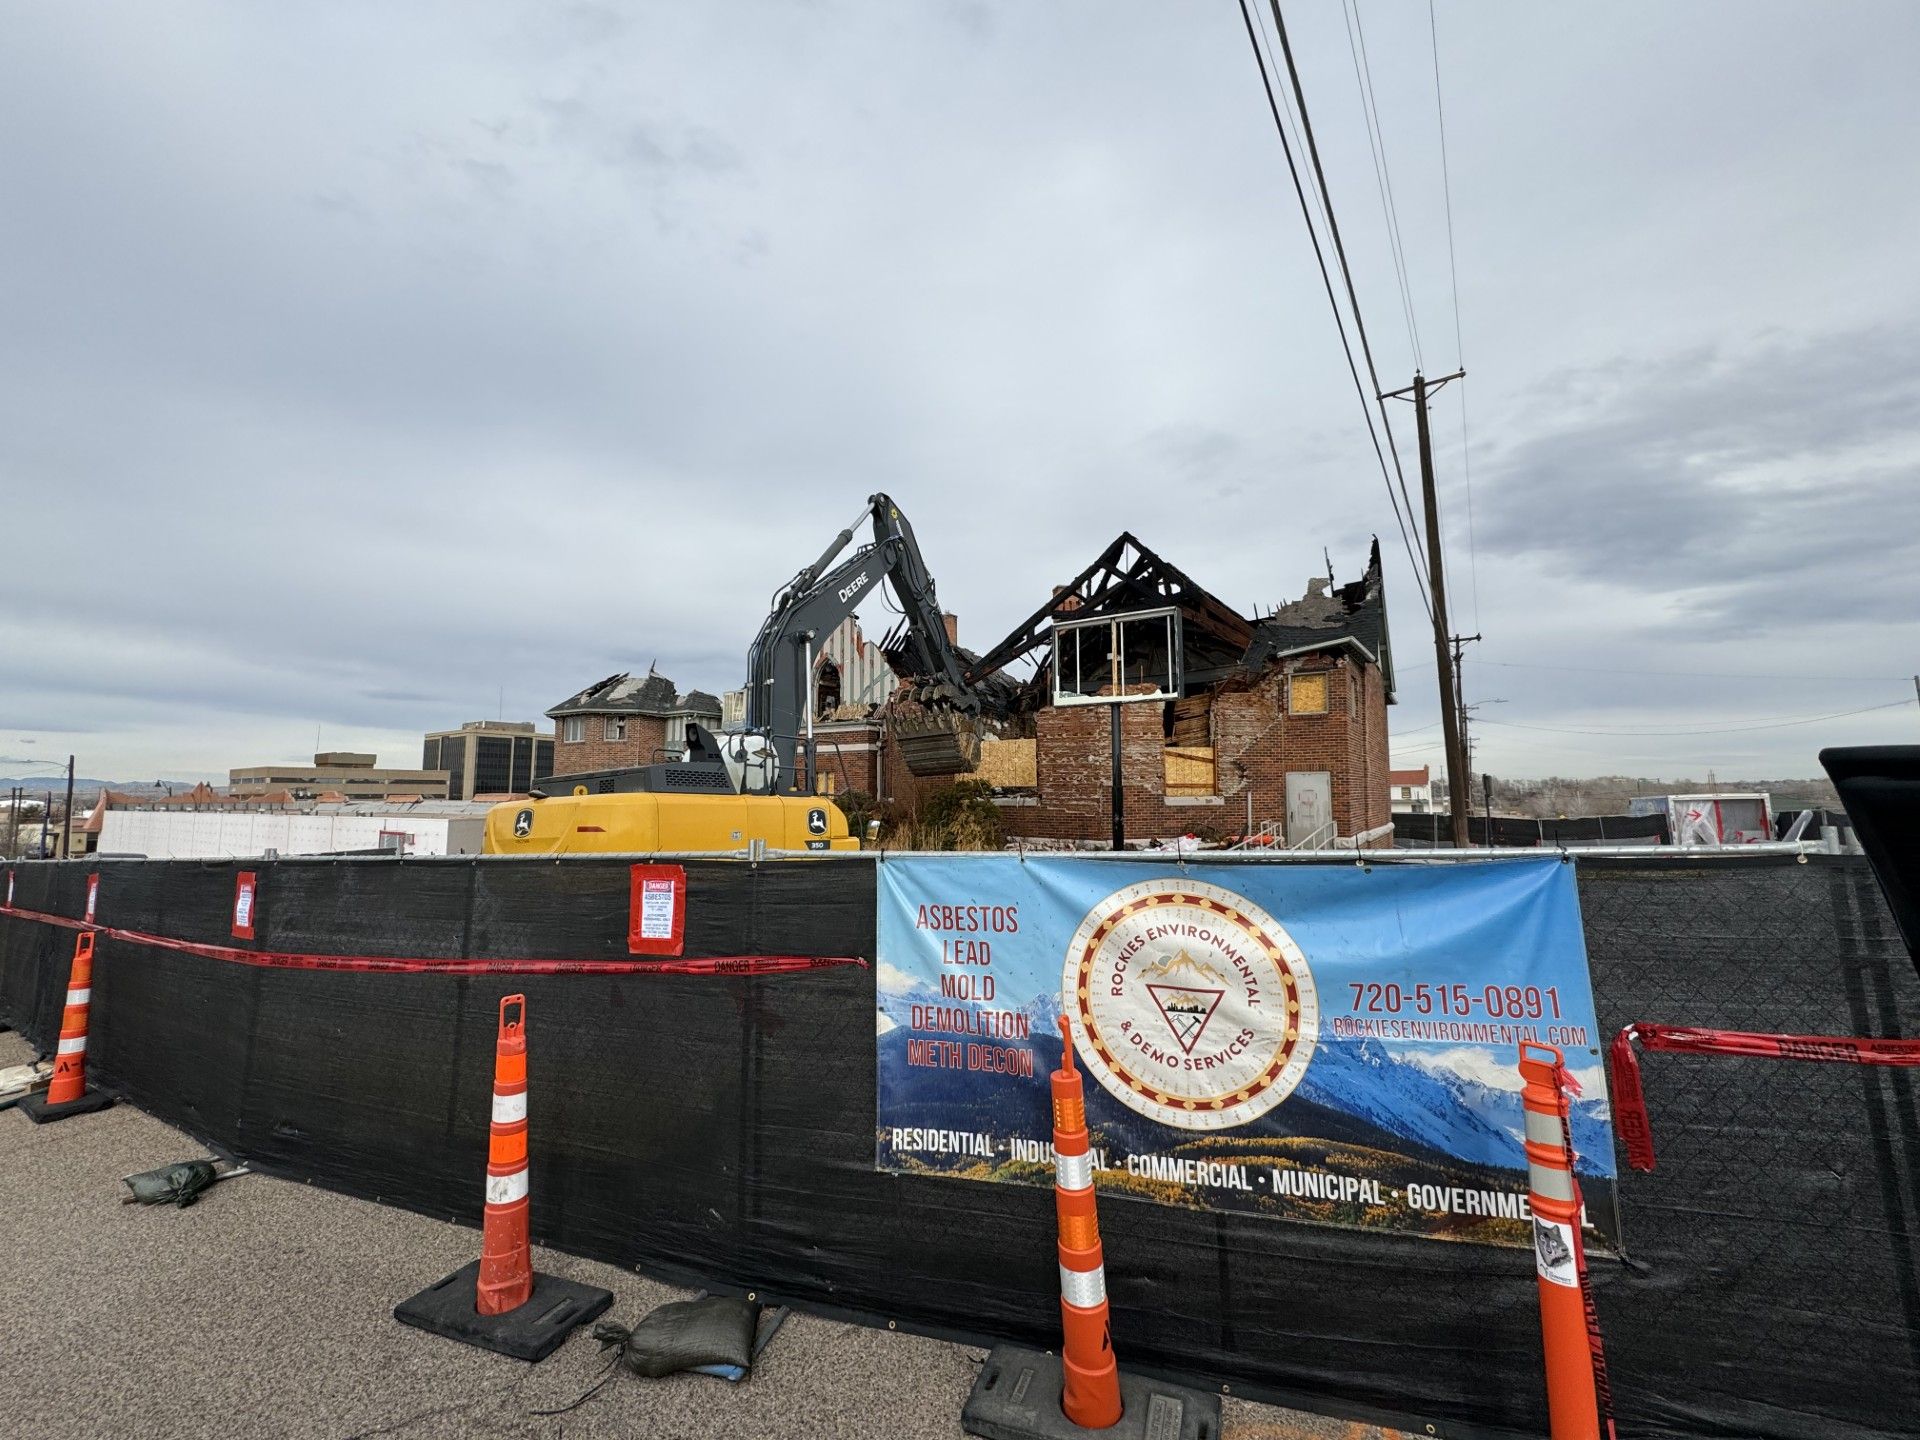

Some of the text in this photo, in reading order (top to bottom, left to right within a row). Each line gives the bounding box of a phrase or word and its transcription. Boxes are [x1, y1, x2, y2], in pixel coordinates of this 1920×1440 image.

[838, 571, 869, 604] DEERE
[916, 904, 1018, 933] ASBESTOS
[714, 960, 750, 973] DANGER
[943, 939, 991, 966] LEAD
[1111, 923, 1261, 1007] ROCKIES ENVIRONMENTAL
[940, 973, 995, 1001] MOLD
[1348, 982, 1562, 1020] 720-515-0891
[911, 1005, 1030, 1040] DEMOLITION
[1333, 1016, 1588, 1047] ROCKIESENVIRONMENTAL.COM
[908, 1038, 1033, 1078] METH DECON
[1120, 1020, 1255, 1071] & DEMO SERVICES
[891, 1126, 1595, 1228] RESIDENTIAL INDUAL COMMERCIAL MUNICIPAL GOVERNMEL
